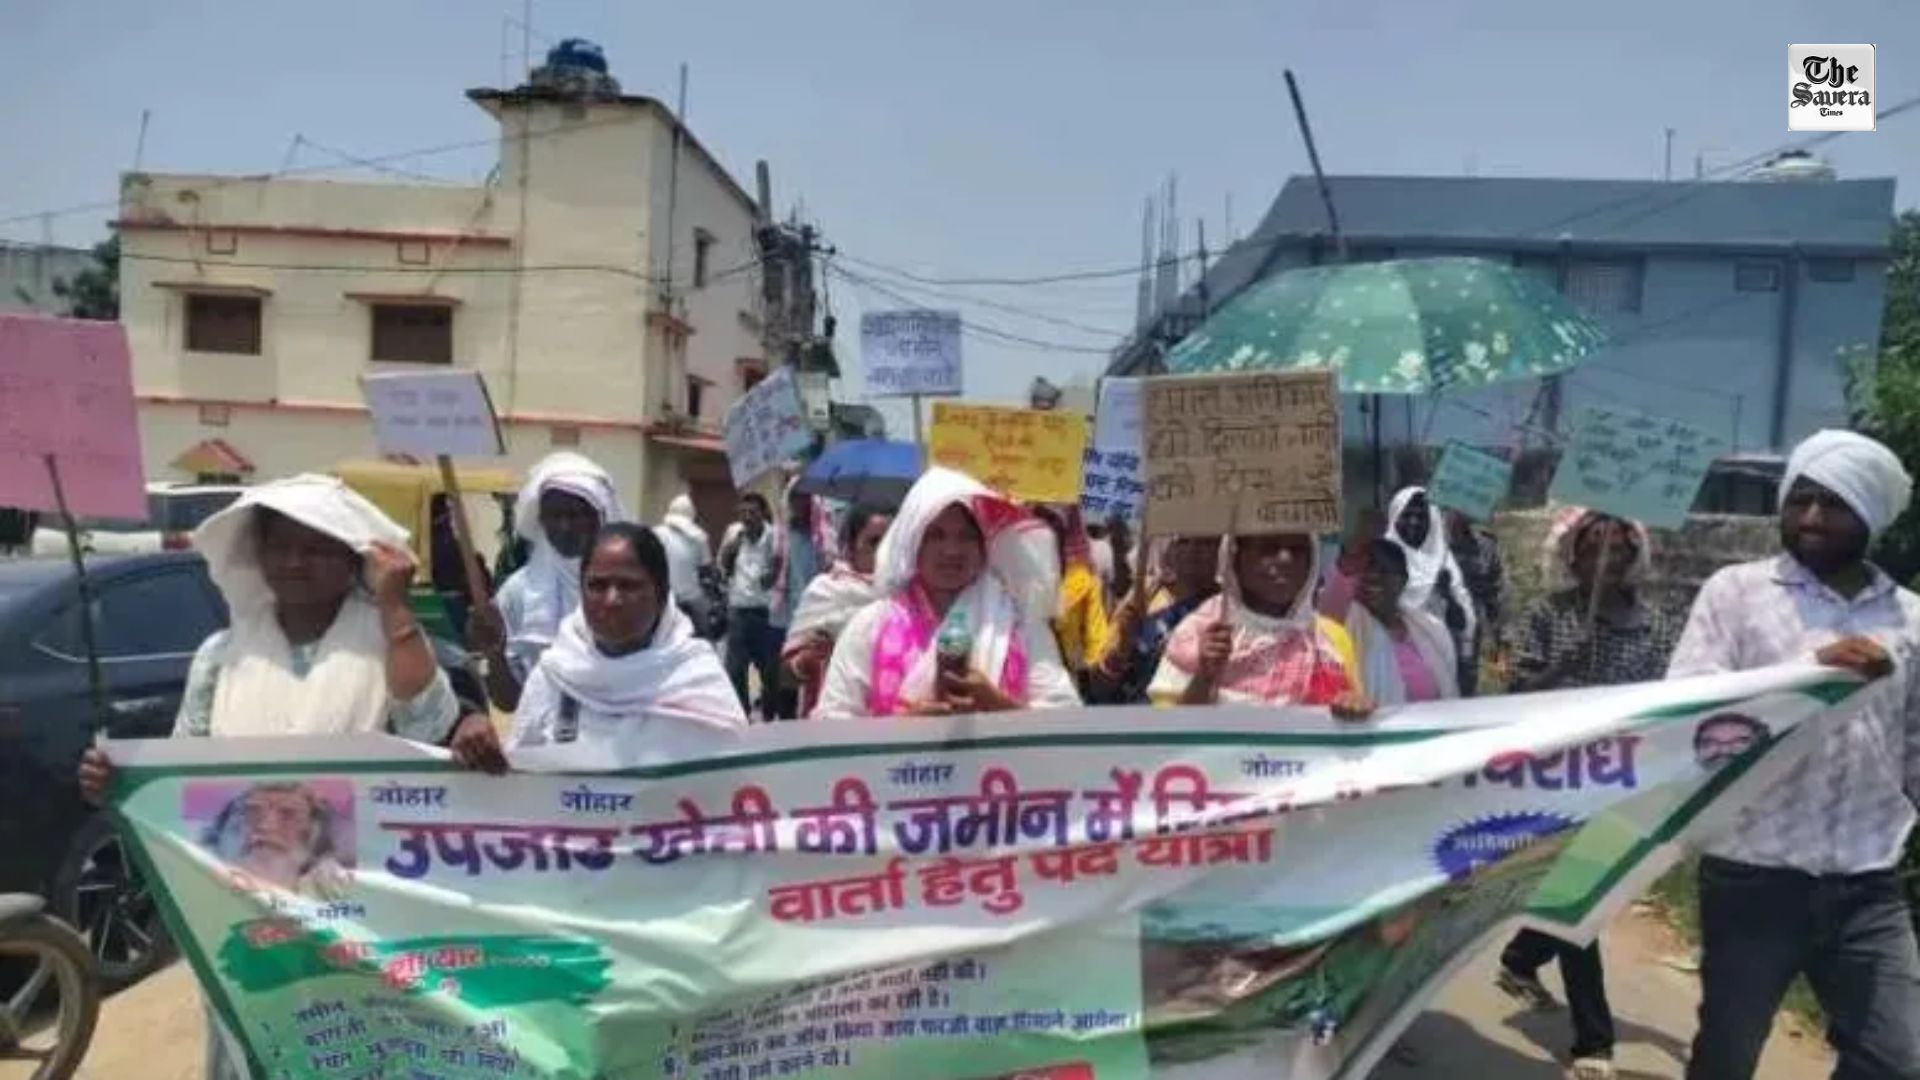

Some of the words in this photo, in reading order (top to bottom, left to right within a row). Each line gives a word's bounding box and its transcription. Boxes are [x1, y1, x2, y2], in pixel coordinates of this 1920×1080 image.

[886, 760, 956, 787] जोहार
[1240, 753, 1306, 777] जोहार
[370, 780, 448, 808] जोहार
[560, 785, 636, 812] जोहार
[790, 778, 881, 855] की
[887, 768, 1073, 855] जमीन
[1082, 767, 1142, 843] में
[768, 857, 906, 922] वार्ता
[917, 855, 1024, 915] हेतु
[1028, 842, 1122, 883] पद
[1135, 827, 1276, 868] यात्रा
